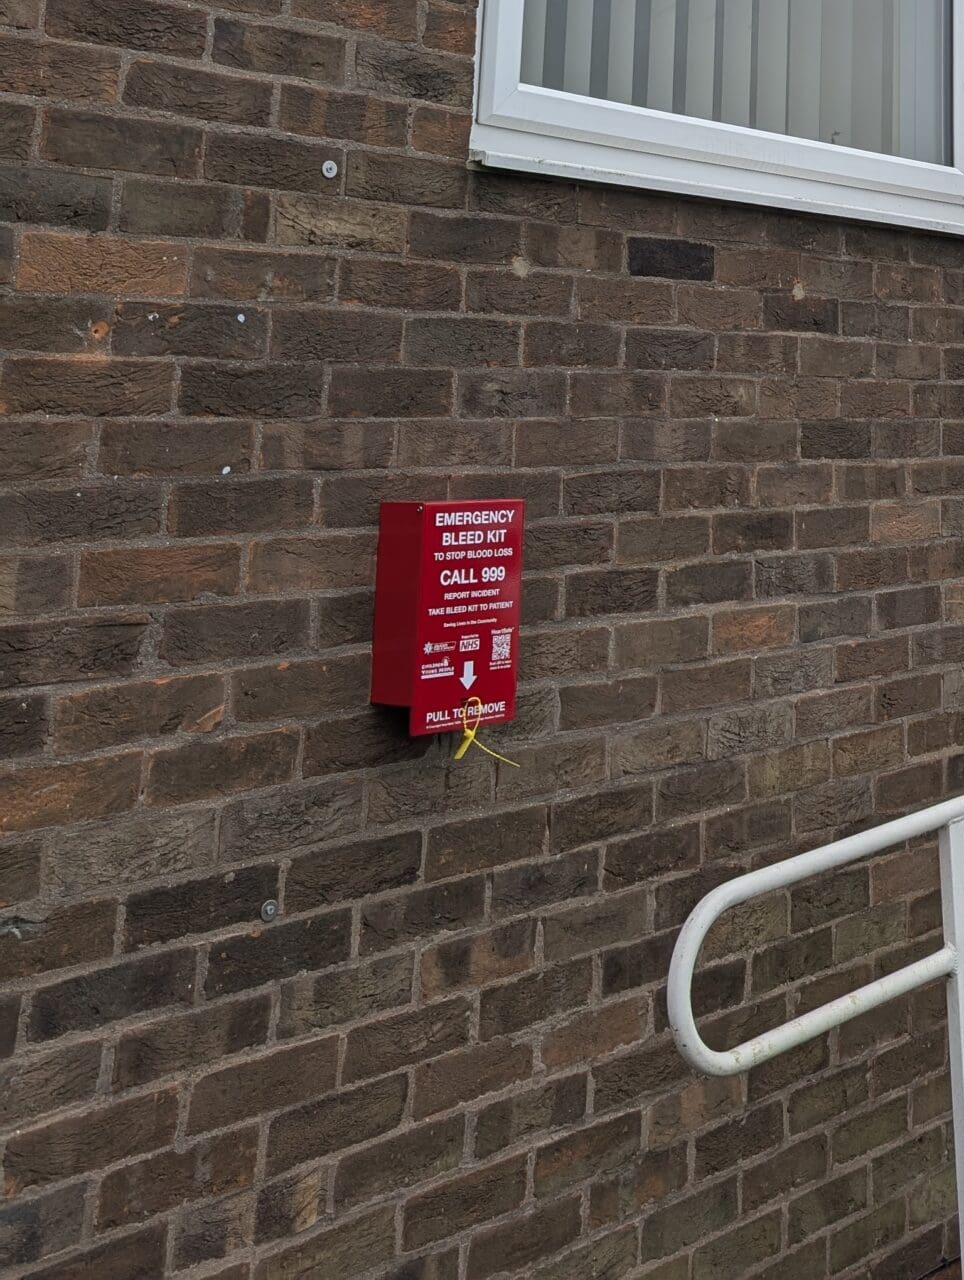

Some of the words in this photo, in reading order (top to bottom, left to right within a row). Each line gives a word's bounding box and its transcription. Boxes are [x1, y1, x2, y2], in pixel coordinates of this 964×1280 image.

[435, 510, 515, 527] EMERGENCY
[442, 530, 484, 546] BLEED
[487, 529, 507, 543] KIT
[434, 552, 445, 561] TO
[446, 550, 466, 561] STOP
[467, 549, 493, 559] BLOOD
[494, 547, 513, 557] LOSS
[440, 568, 478, 586] CALL
[481, 566, 506, 583] 999
[444, 591, 470, 600] REPORT
[470, 588, 500, 598] INCIDENT
[428, 608, 445, 616] TAKE
[446, 605, 467, 615] BLEED
[468, 604, 479, 612] KIT
[480, 603, 488, 611] TO
[489, 601, 514, 610] PATIENT
[460, 639, 480, 650] NHS
[426, 710, 451, 723] PULL
[452, 707, 466, 719] TO
[467, 700, 506, 717] REMOVE
